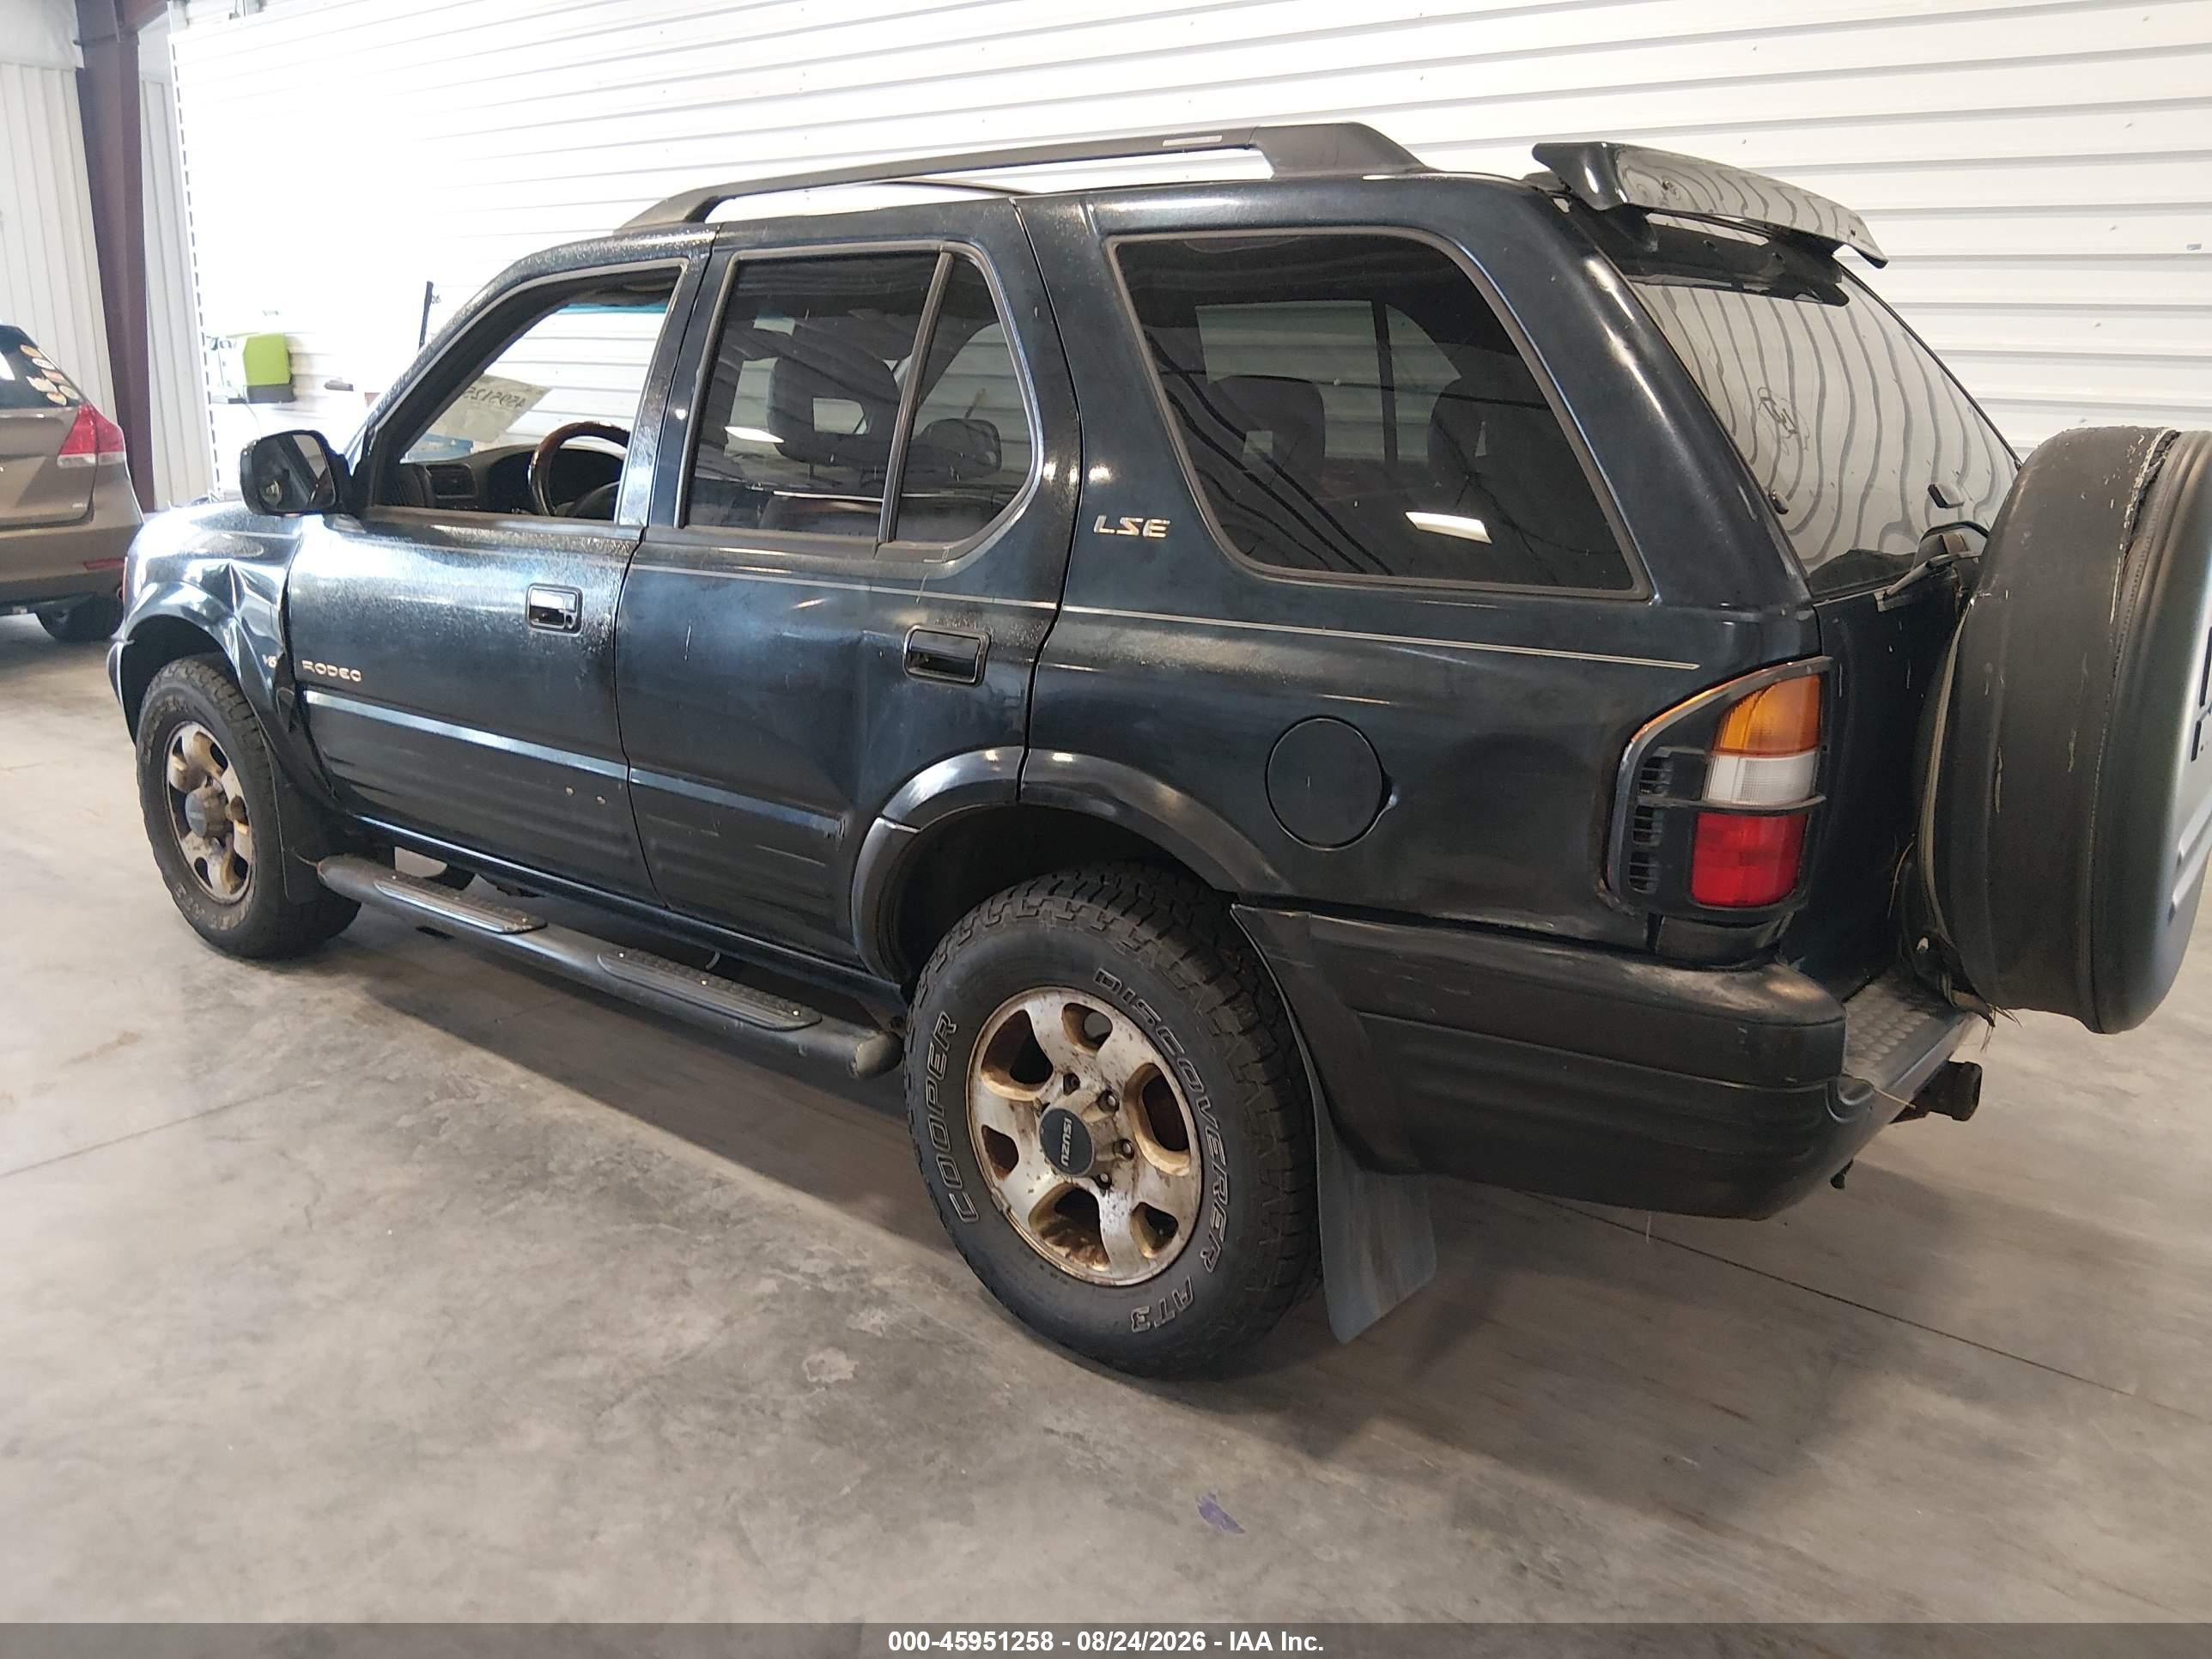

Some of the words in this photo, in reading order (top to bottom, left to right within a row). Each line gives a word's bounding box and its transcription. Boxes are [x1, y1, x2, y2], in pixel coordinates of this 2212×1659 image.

[1093, 514, 1171, 537] LSE
[301, 659, 362, 683] RODEO
[925, 1011, 981, 1224] COOPER
[1060, 1116, 1073, 1167] ISUZU
[1092, 967, 1231, 1273] DISCOVERER
[1129, 1275, 1195, 1334] AT3
